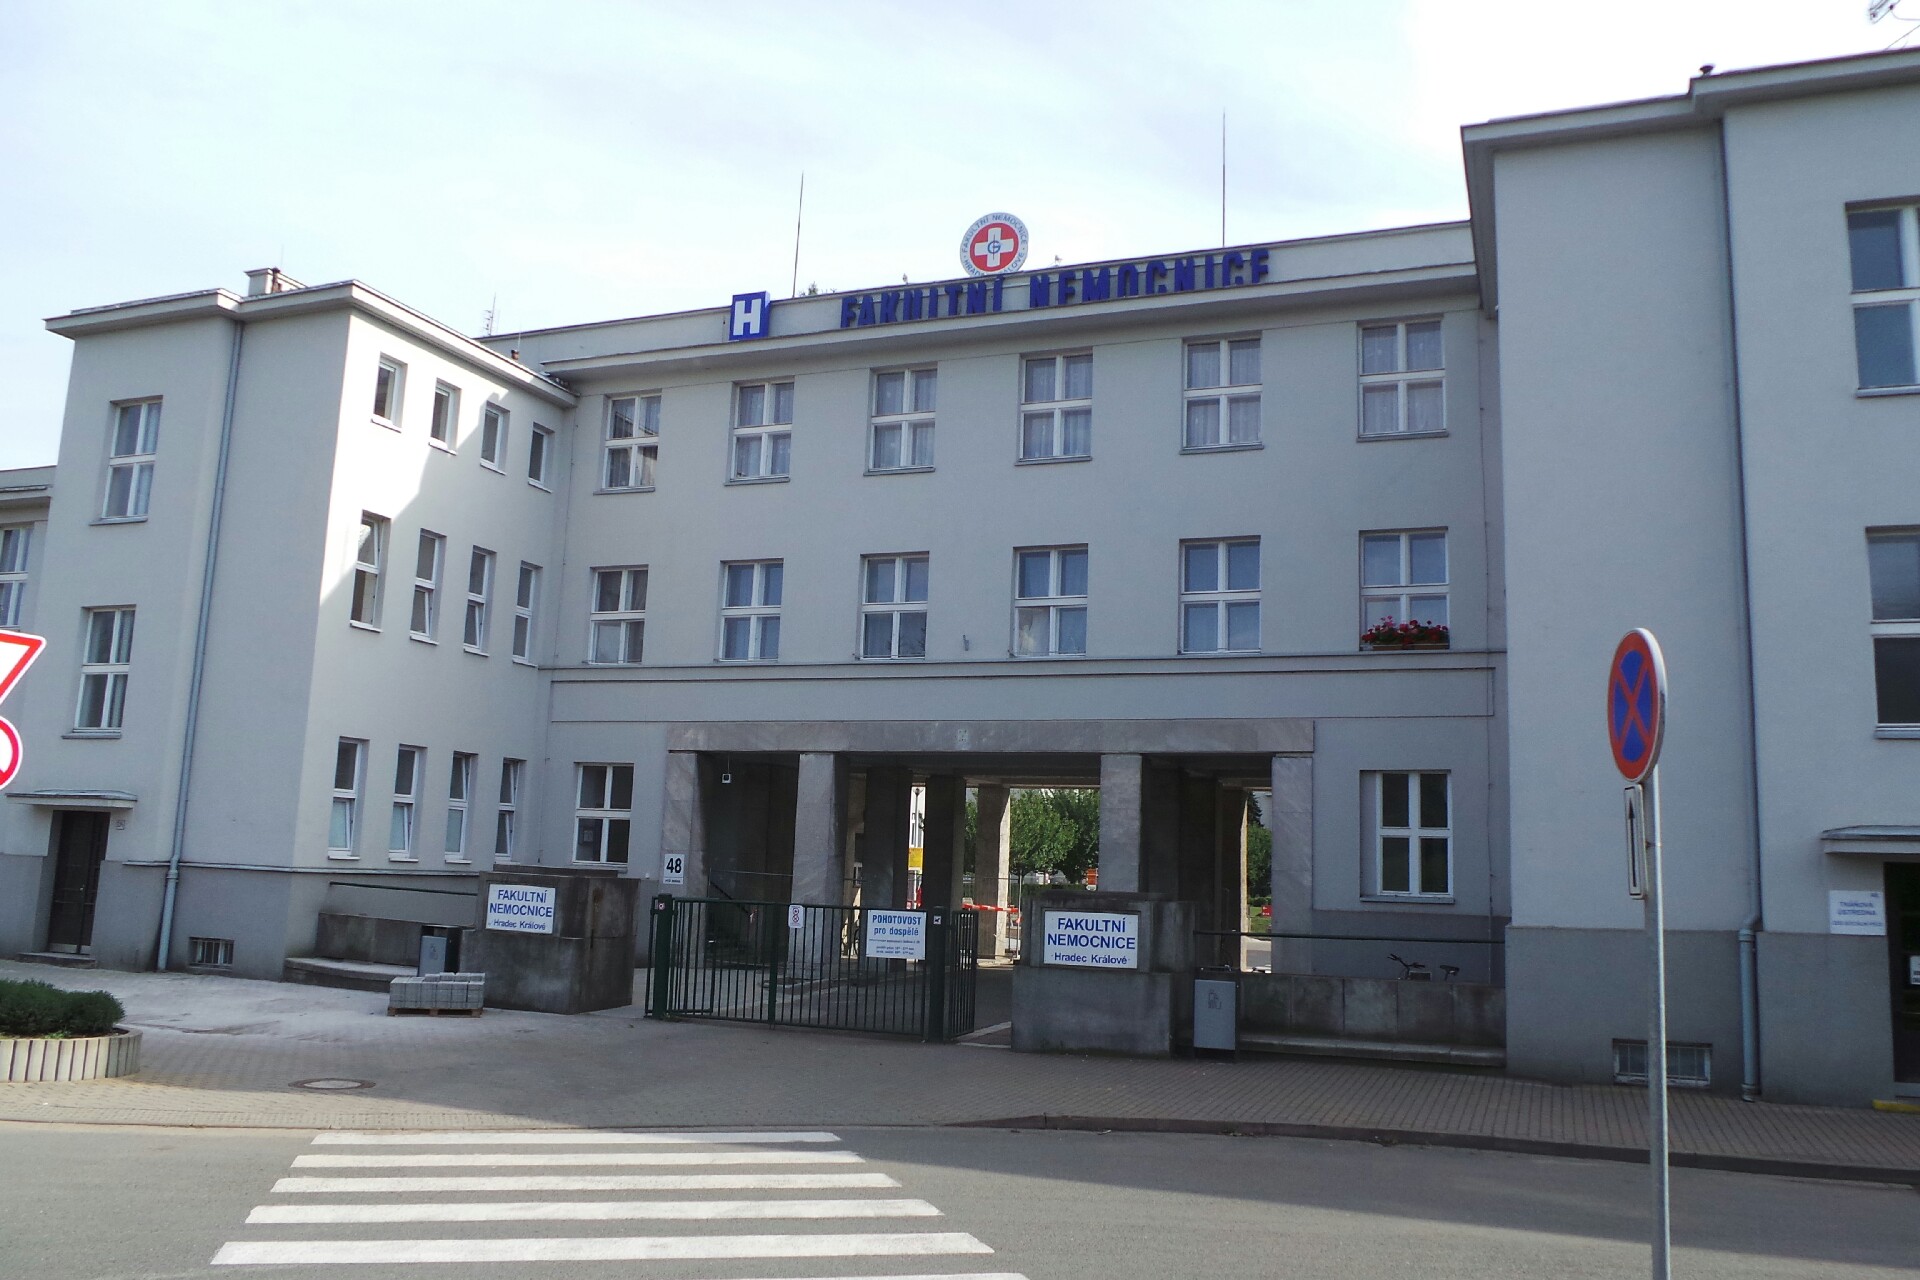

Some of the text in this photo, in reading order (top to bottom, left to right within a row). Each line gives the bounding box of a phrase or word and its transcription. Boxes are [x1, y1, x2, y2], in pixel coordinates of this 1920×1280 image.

[992, 213, 1028, 245] NEMOCNICE
[1029, 249, 1270, 308] NEMOCNICE
[732, 298, 762, 336] H
[666, 857, 682, 874] 48
[497, 889, 548, 903] FAKULTNÍ
[489, 902, 553, 918] NEMOCNICE
[493, 919, 546, 931] Hradec Králové
[872, 914, 922, 926] POHOTOVOST
[1057, 917, 1126, 933] FAKULTNÍ
[873, 926, 919, 937] pro dospělé
[1047, 933, 1136, 950] NEMOCNICE
[1054, 952, 1128, 965] Hradec Králové
